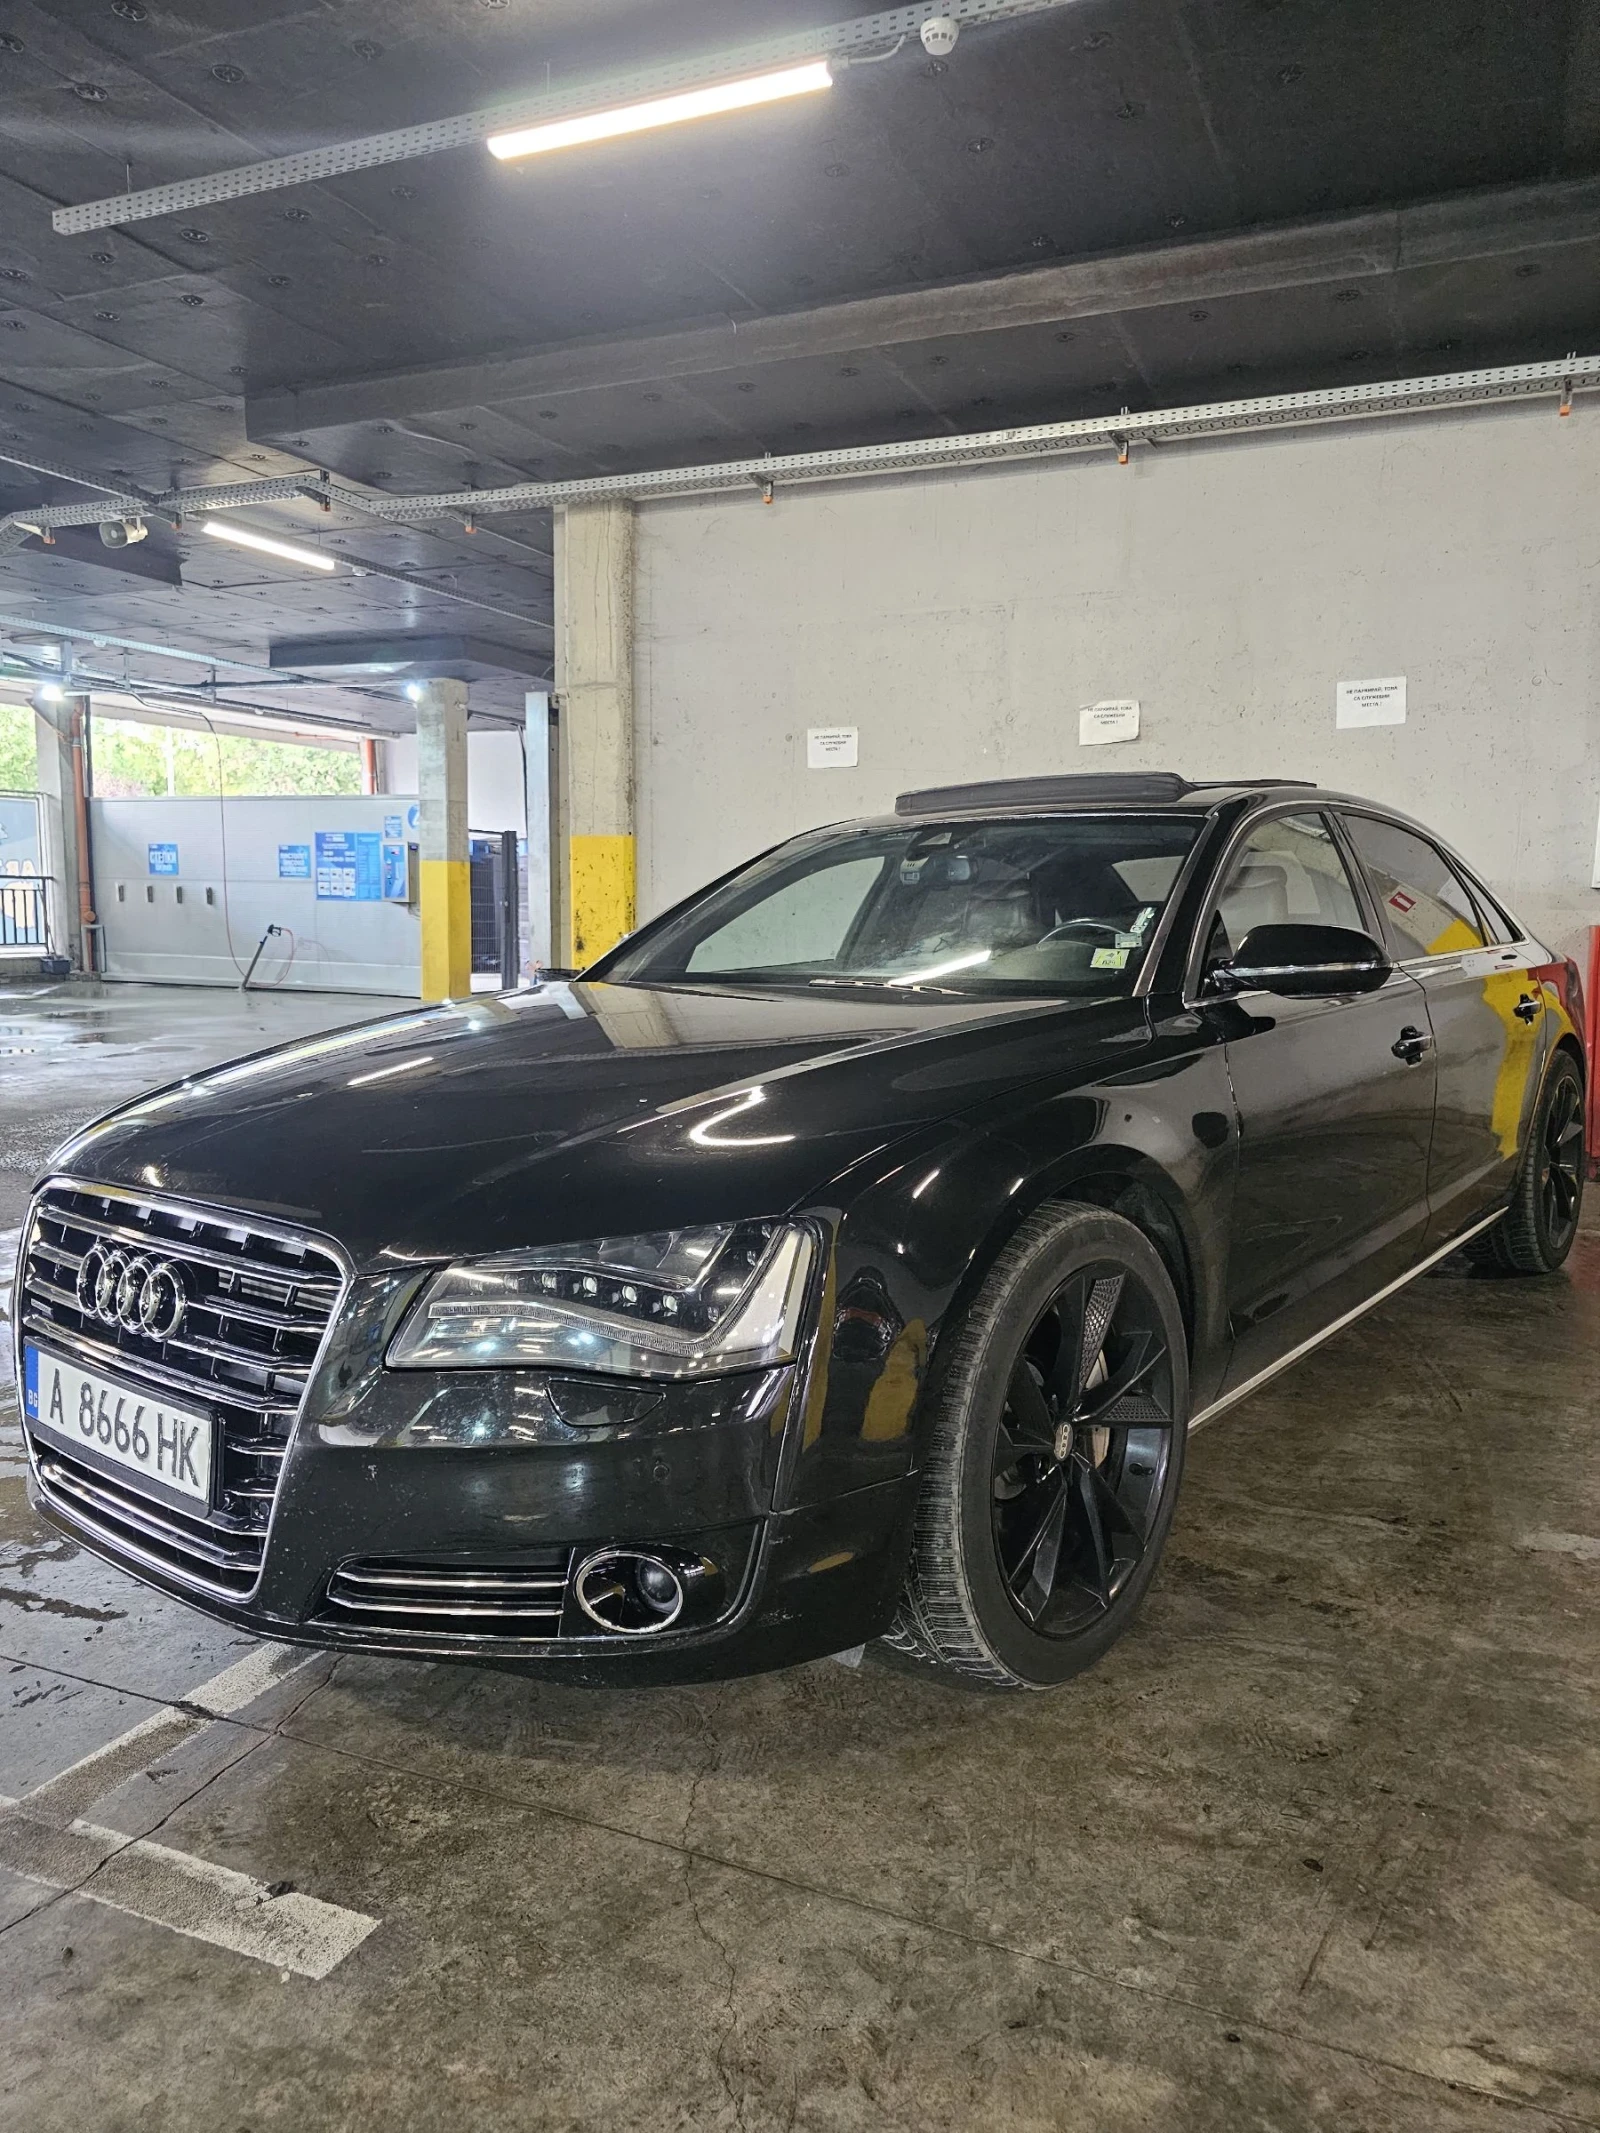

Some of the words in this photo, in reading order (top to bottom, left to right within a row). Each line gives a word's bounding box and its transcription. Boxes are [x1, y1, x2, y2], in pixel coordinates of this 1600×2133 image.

[27, 1388, 39, 1408] BG
[49, 1367, 65, 1425] A
[78, 1381, 150, 1461] 8666
[157, 1411, 200, 1487] HK
